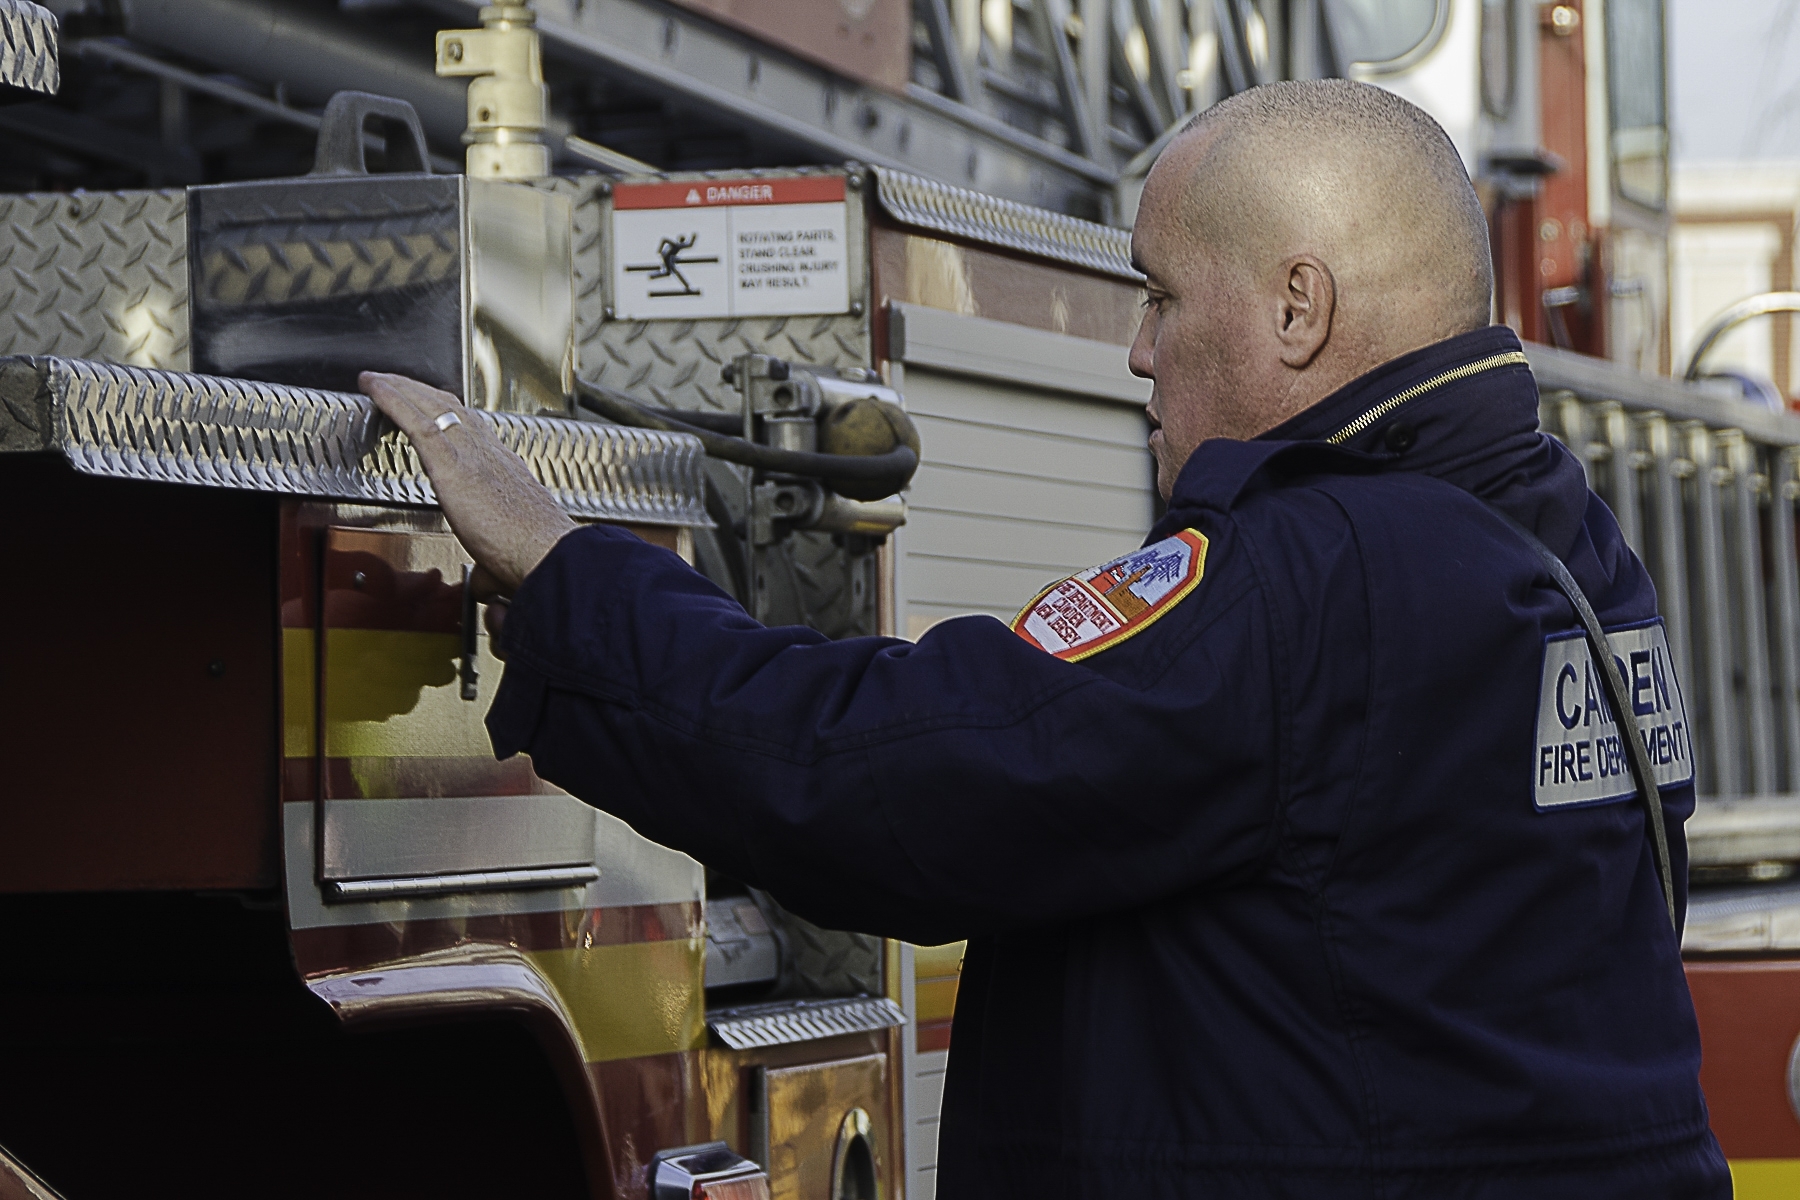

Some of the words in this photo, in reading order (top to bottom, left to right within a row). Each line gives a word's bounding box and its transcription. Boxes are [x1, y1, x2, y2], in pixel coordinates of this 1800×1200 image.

[706, 184, 774, 202] DANGER
[739, 231, 794, 244] ROTATING
[739, 247, 775, 259] STAND
[739, 263, 795, 275] CRUSHING
[799, 260, 838, 272] INJURY
[740, 278, 763, 289] MAY
[1555, 646, 1671, 731] CAEN
[1539, 740, 1593, 787] FIRE
[1595, 720, 1685, 779] DEPMENT
